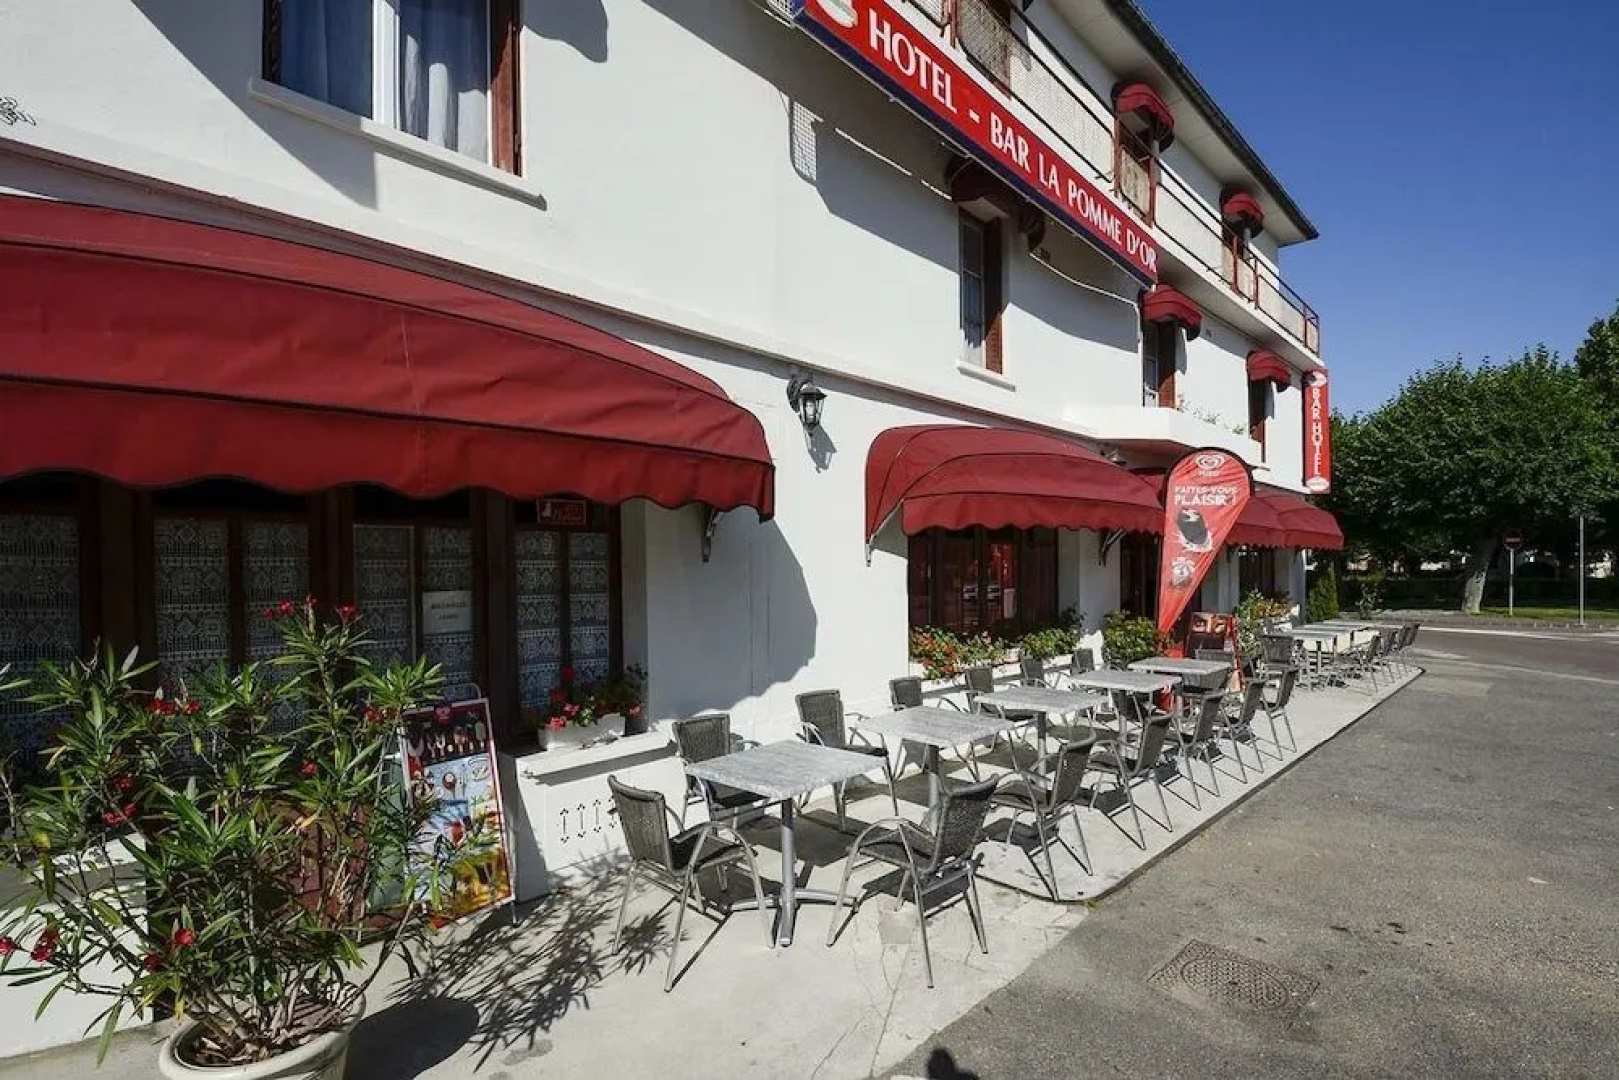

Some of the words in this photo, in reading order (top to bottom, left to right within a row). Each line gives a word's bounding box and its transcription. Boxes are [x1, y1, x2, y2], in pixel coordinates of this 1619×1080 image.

[868, 8, 957, 114] HOTEL
[990, 112, 1032, 174] BAR
[1038, 153, 1060, 198] LA
[1067, 182, 1122, 246] POMME
[1127, 228, 1158, 273] D'OR
[1174, 494, 1227, 506] PLAISIR
